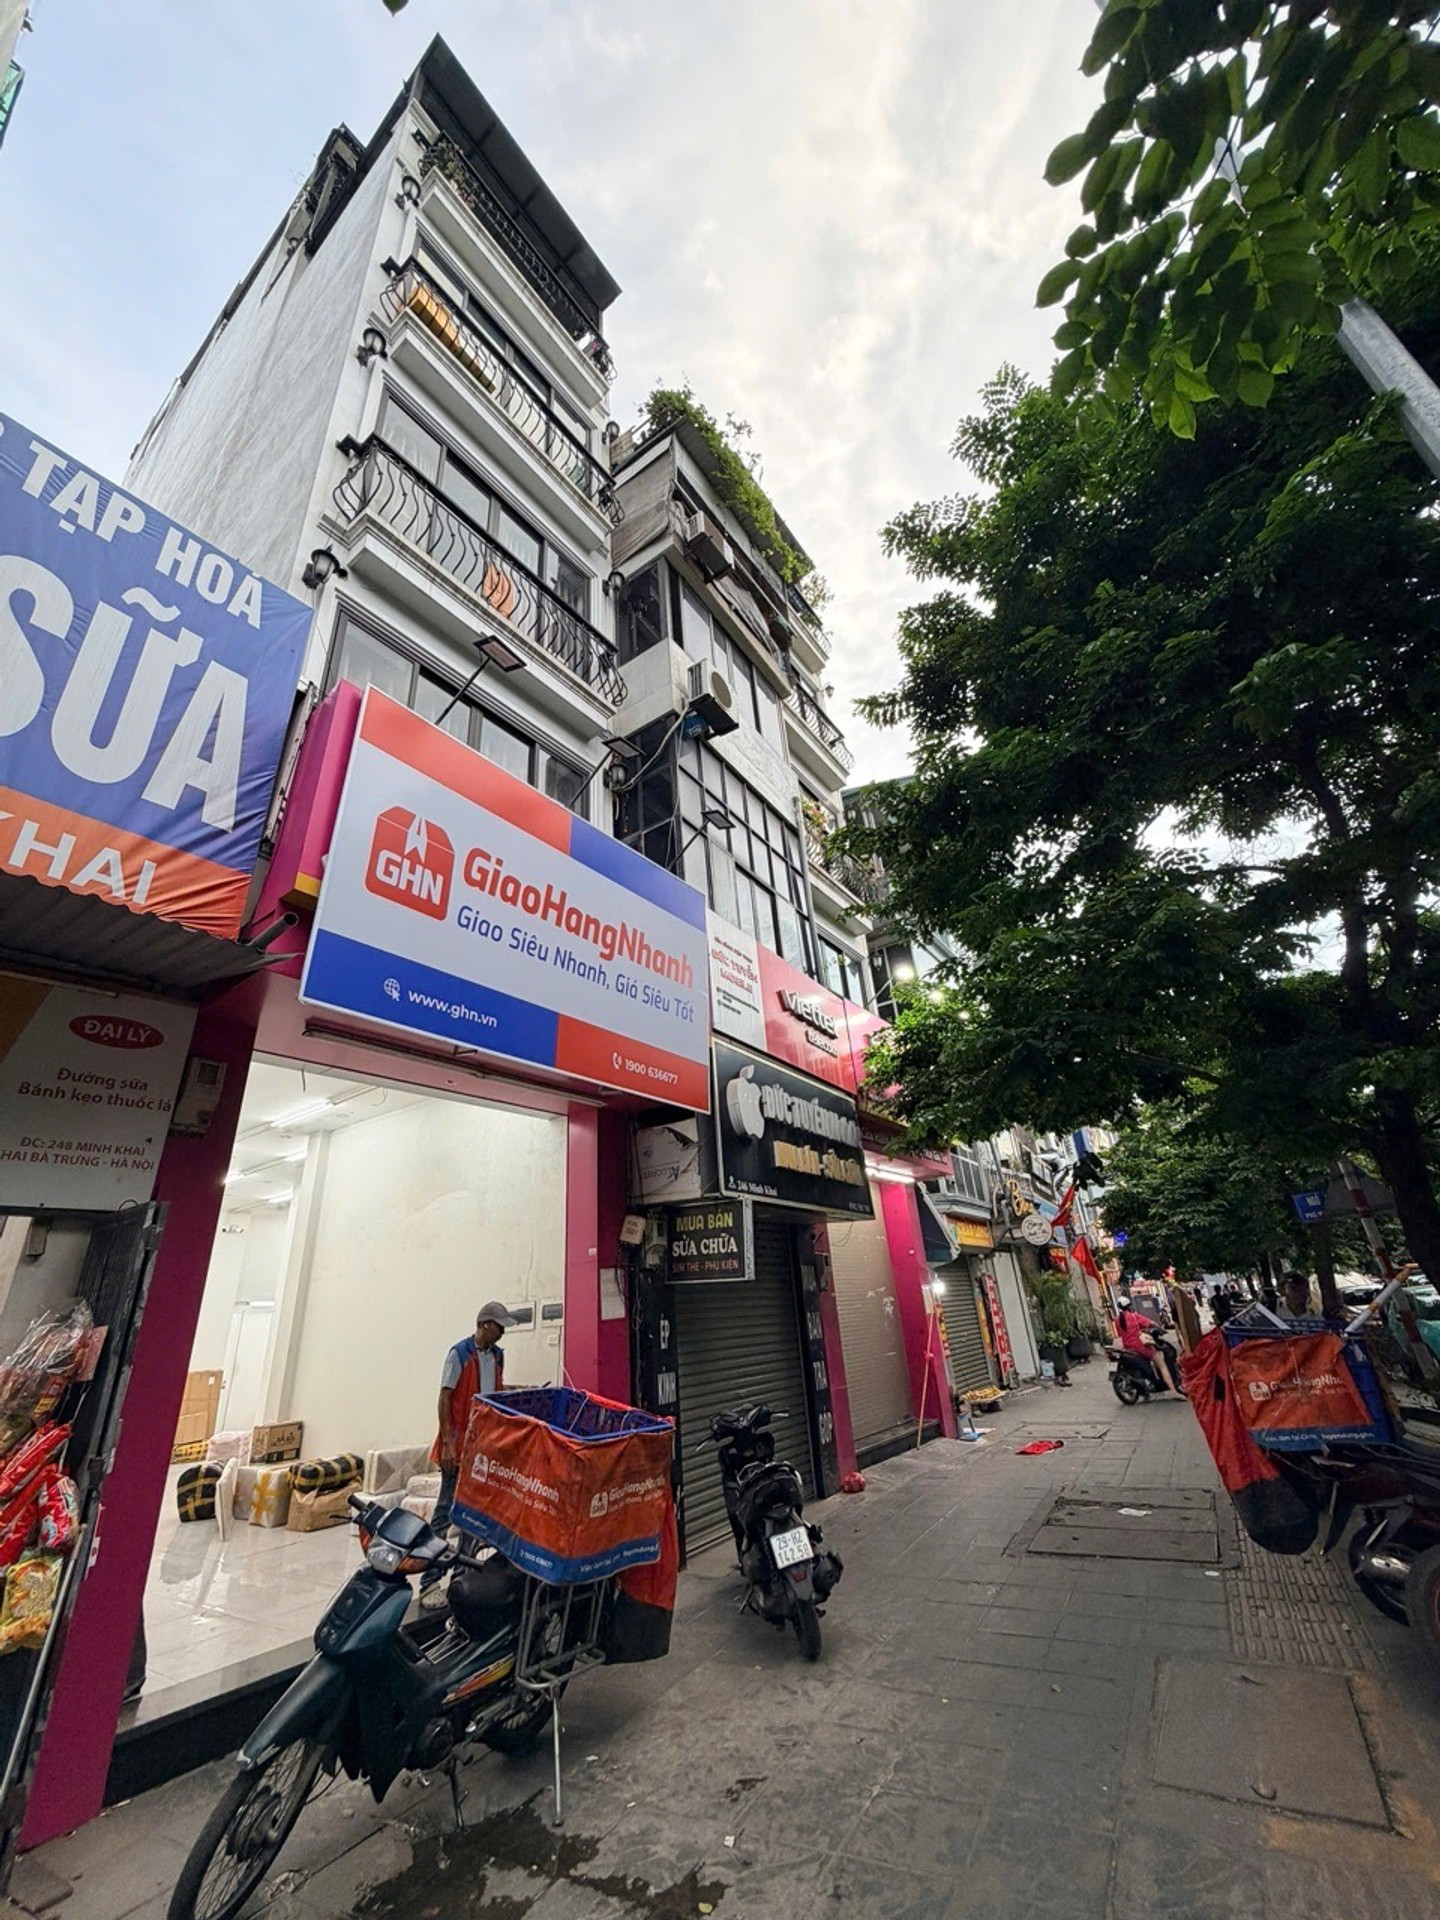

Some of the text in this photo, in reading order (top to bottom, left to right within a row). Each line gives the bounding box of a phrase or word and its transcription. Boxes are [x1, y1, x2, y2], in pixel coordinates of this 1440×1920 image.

[21, 440, 146, 542] TẠP
[0, 554, 248, 834] SỮA
[0, 811, 156, 905] HAI
[375, 848, 444, 906] GHN
[463, 846, 694, 990] GiaoHangNhanh
[457, 904, 503, 942] Giao
[508, 926, 548, 962] Siêu
[553, 945, 611, 991] Nhanh,
[614, 973, 639, 1001] Giá
[642, 982, 671, 1014] Siêu
[673, 993, 695, 1024] Tốt
[408, 988, 498, 1028] www.ghn.vn
[84, 1018, 151, 1043] ĐẠI LÝ
[57, 1066, 120, 1091] Đường
[624, 1058, 679, 1085] 1900 636677
[18, 1080, 66, 1101] Bánh
[71, 1089, 103, 1107] kẹo
[107, 1096, 154, 1111] thuốc
[20, 1136, 146, 1157] ĐC: 248 MINH KHAI
[30, 1150, 49, 1164] BÀ
[52, 1152, 100, 1168] TRƯNG
[110, 1157, 130, 1169] HÀ
[676, 1208, 733, 1232] MUA BÁN
[672, 1232, 738, 1257] SỬA CHỮA
